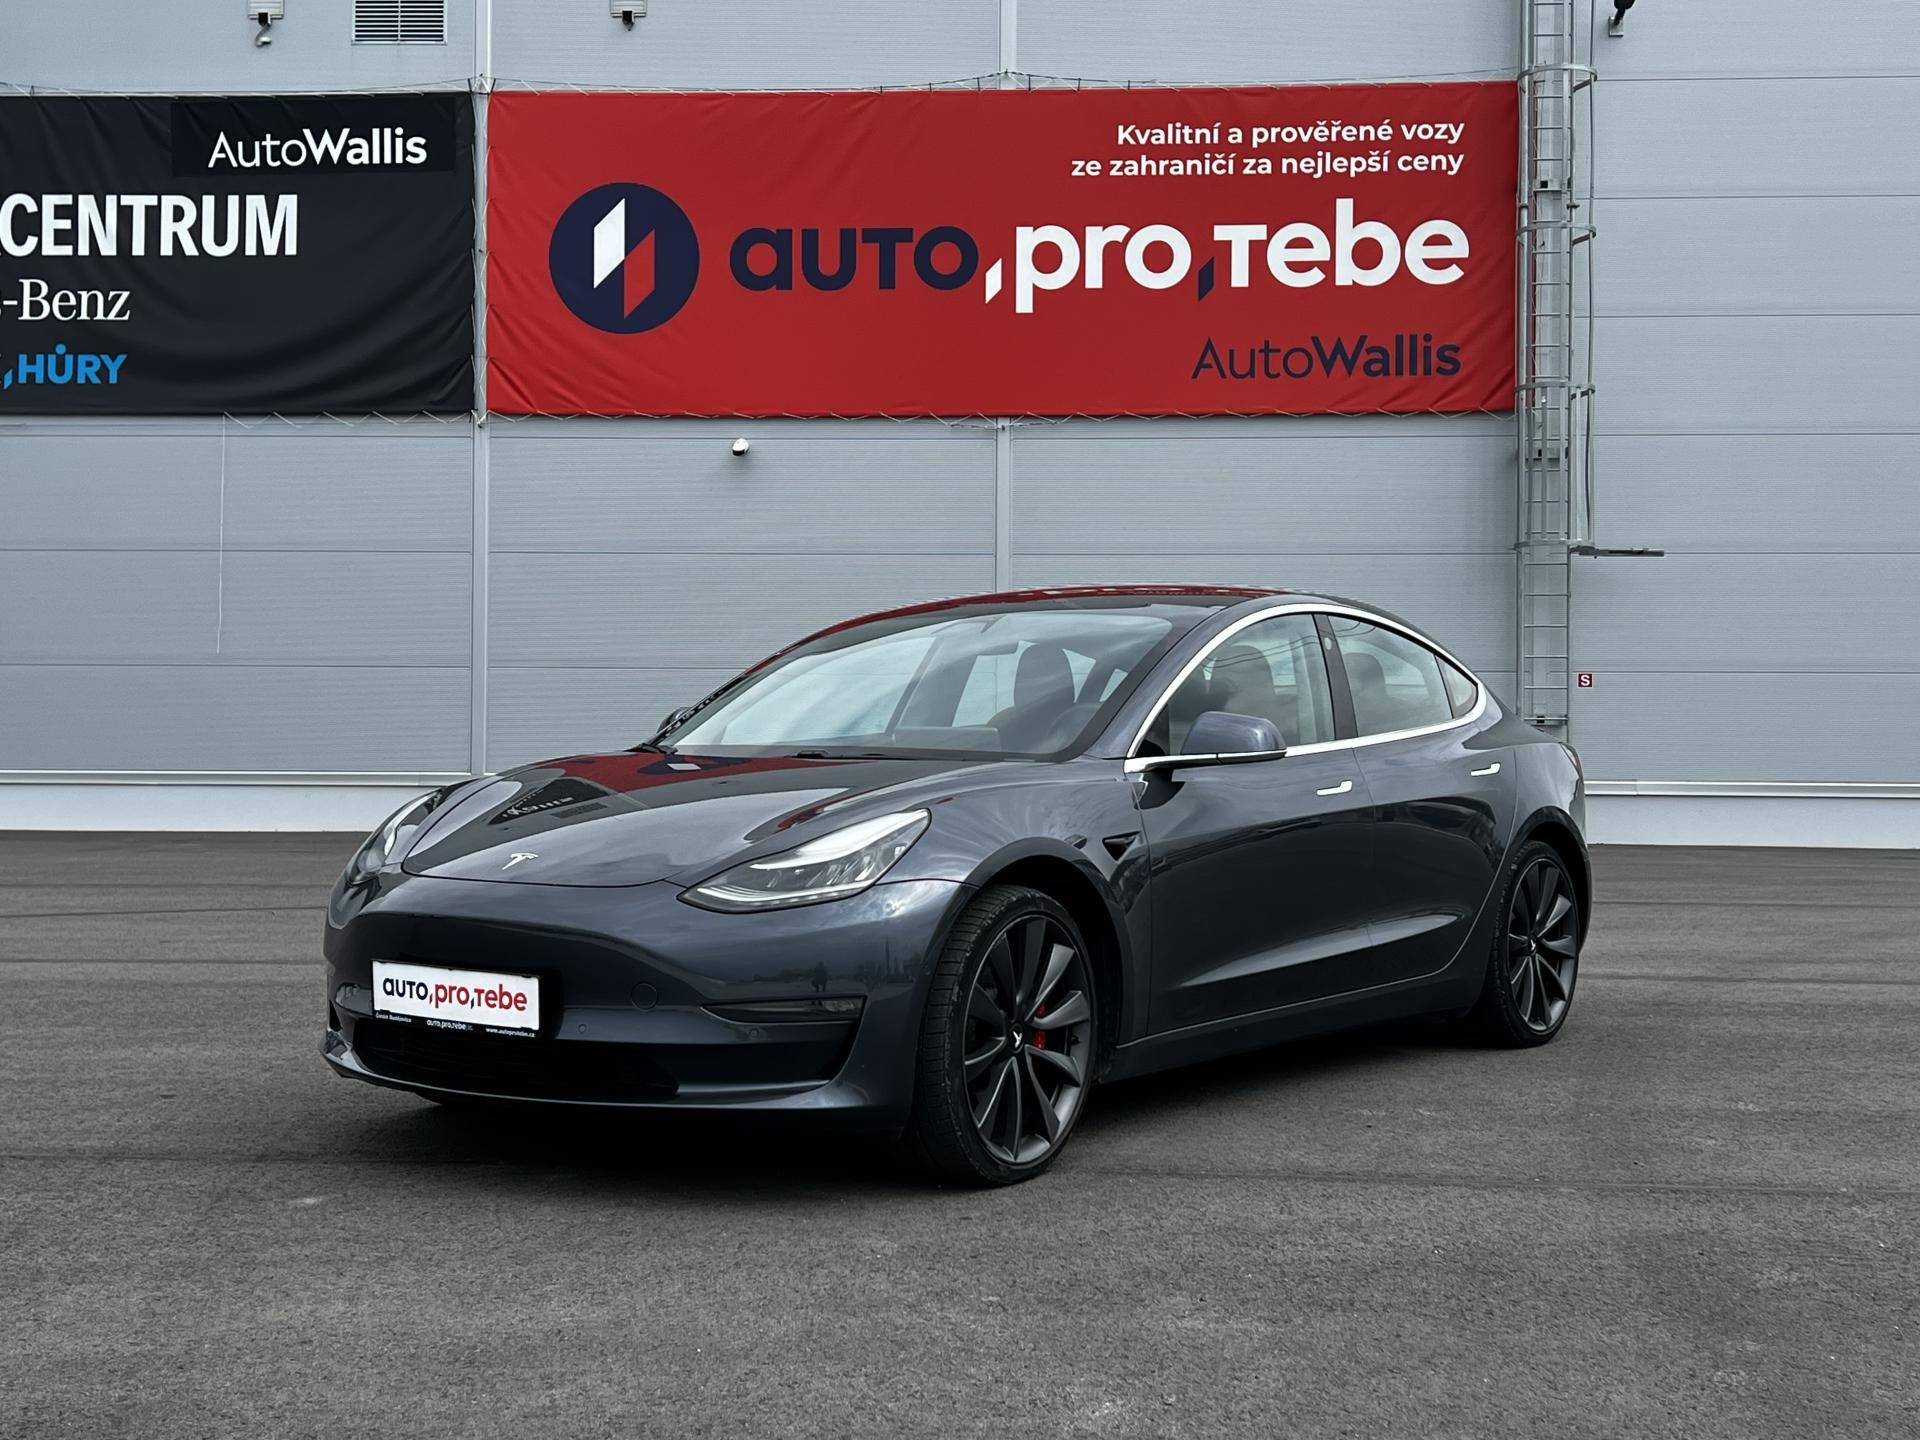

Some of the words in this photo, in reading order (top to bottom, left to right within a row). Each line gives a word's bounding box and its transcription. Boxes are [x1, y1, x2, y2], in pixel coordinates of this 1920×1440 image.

[207, 127, 428, 168] AutoWallis
[1117, 122, 1220, 146] Kvalitní
[1227, 128, 1243, 144] a
[1252, 118, 1393, 148] prověřené
[1401, 121, 1464, 146] vozy
[1071, 159, 1102, 176] ze
[1109, 153, 1236, 176] zahraničí
[1243, 158, 1273, 175] za
[1281, 150, 1390, 178] nejlepší
[1398, 153, 1464, 175] ceny
[0, 193, 299, 257] CENTRUM
[0, 279, 130, 321] -Benz
[0, 344, 128, 390] ,HŮRY
[1191, 333, 1462, 380] AutoWallis
[1580, 674, 1590, 686] S
